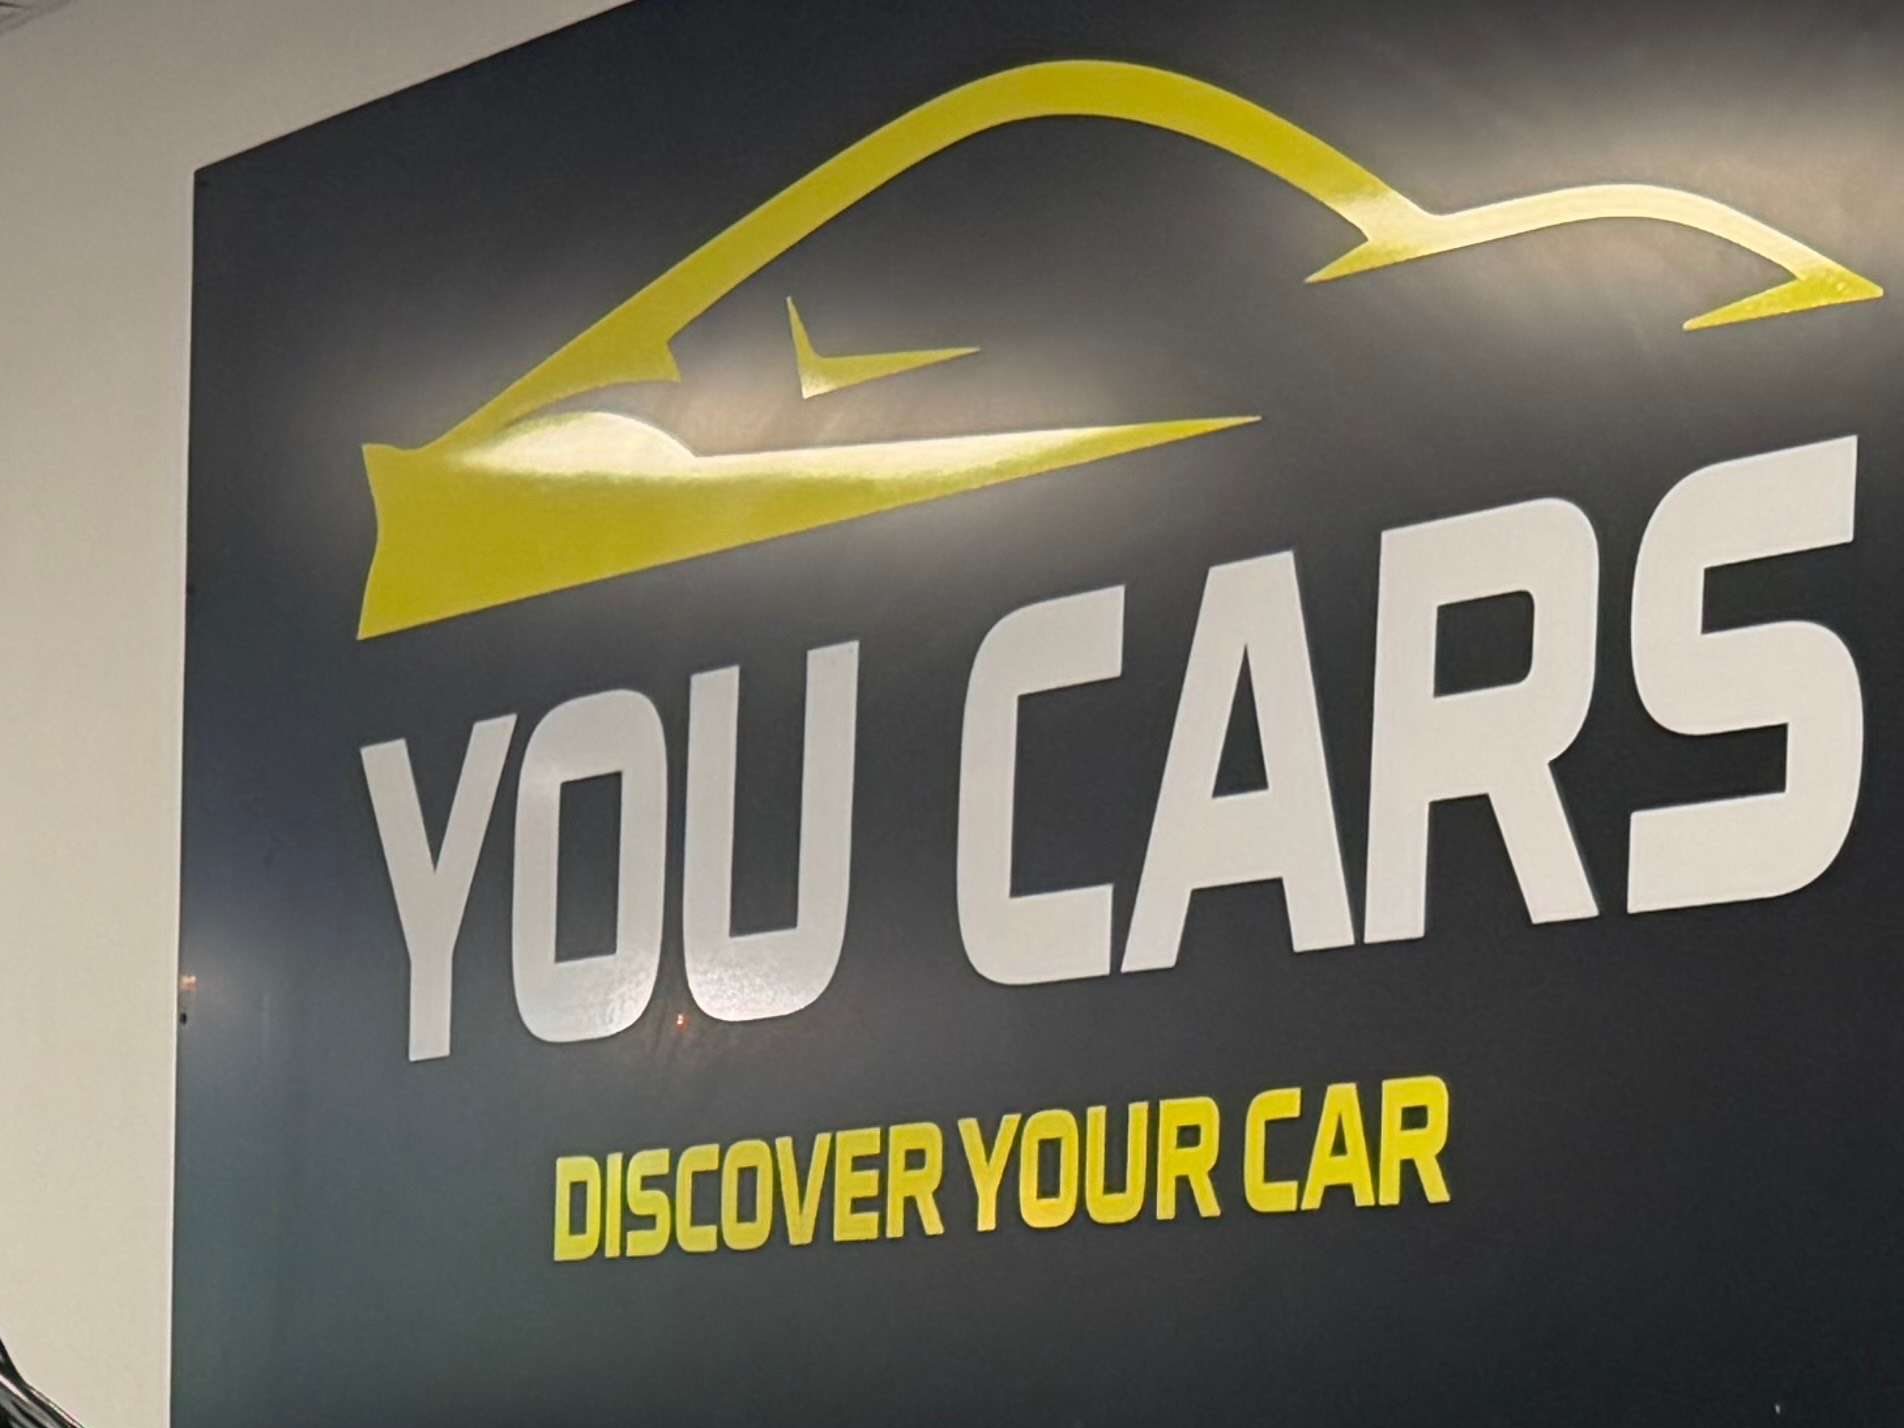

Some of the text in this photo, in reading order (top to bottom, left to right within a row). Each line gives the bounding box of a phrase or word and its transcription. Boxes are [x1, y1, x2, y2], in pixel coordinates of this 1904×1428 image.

[360, 434, 1864, 1061] YOU CARS
[554, 1075, 1451, 1261] DISCOVER YOUR CAR
